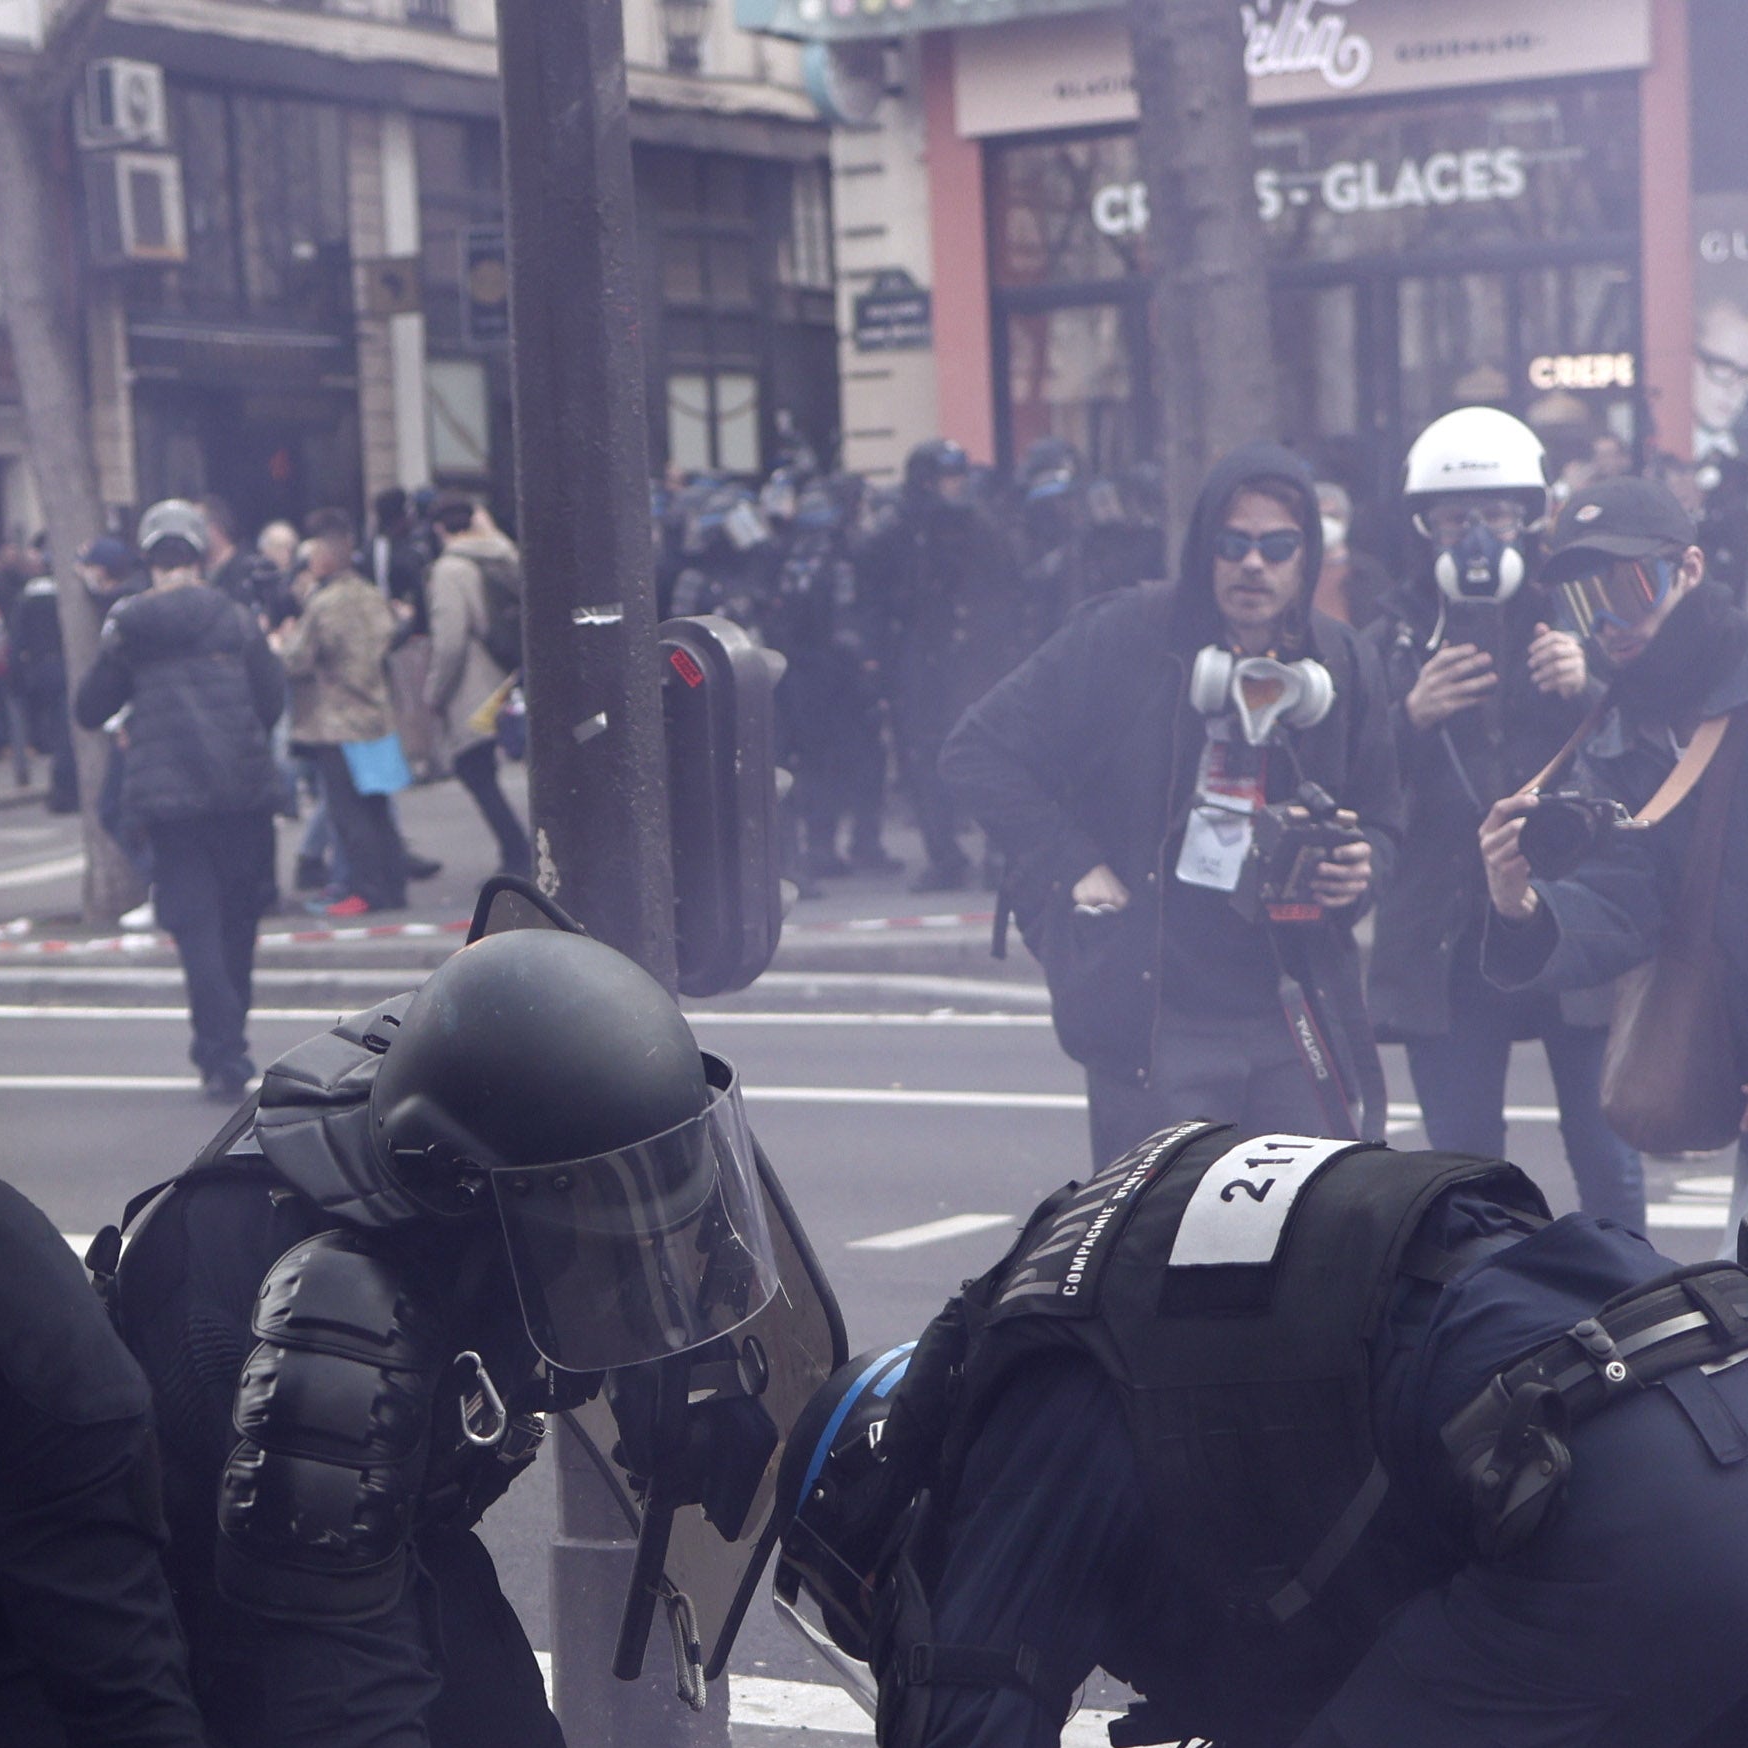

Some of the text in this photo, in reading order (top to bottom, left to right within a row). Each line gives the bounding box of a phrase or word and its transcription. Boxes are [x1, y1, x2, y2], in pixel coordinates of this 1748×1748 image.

[1321, 146, 1525, 213] GLACES
[1220, 1142, 1315, 1203] 211
[1062, 1204, 1117, 1296] COMPAGNIE
